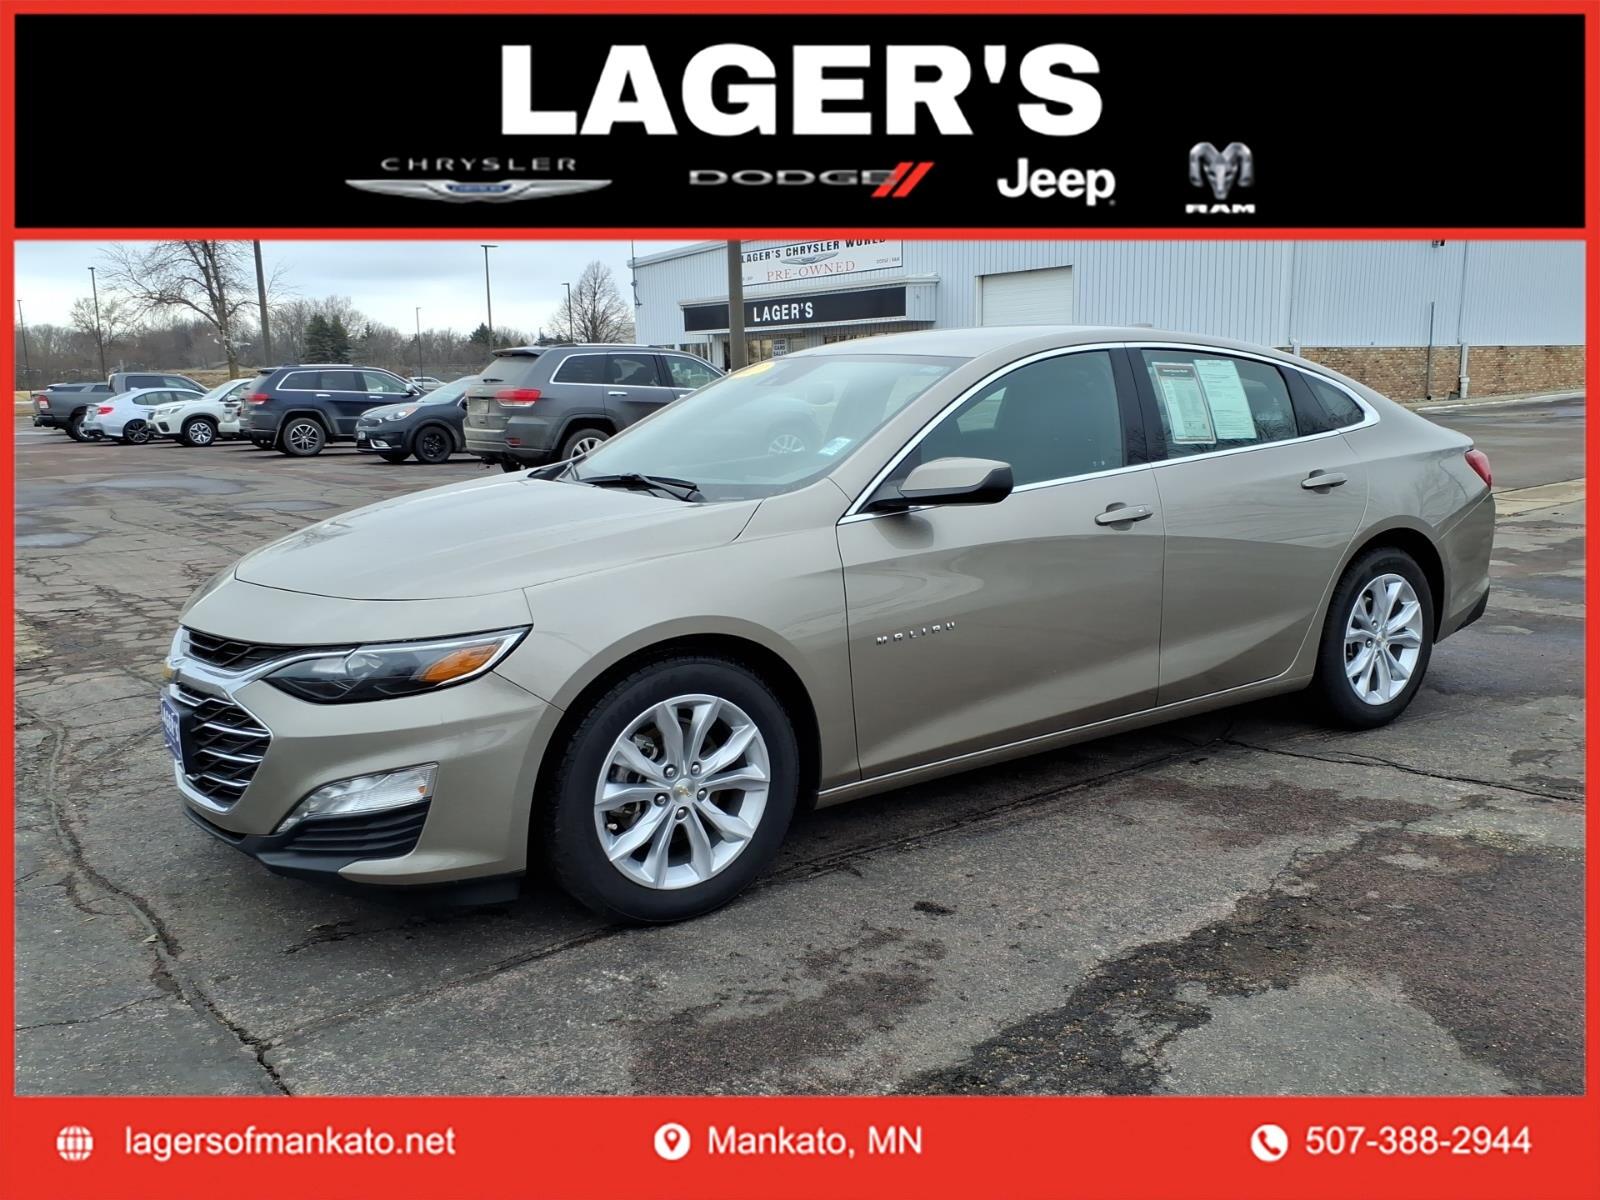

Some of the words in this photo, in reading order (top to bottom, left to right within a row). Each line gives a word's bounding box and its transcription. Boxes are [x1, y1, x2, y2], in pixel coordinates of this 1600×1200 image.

[741, 249, 781, 263] LAGER'S
[786, 240, 840, 257] CHRYSLER
[767, 261, 855, 281] PRE-OWNED
[753, 301, 814, 322] LAGER'S
[876, 621, 956, 645] MALIBU
